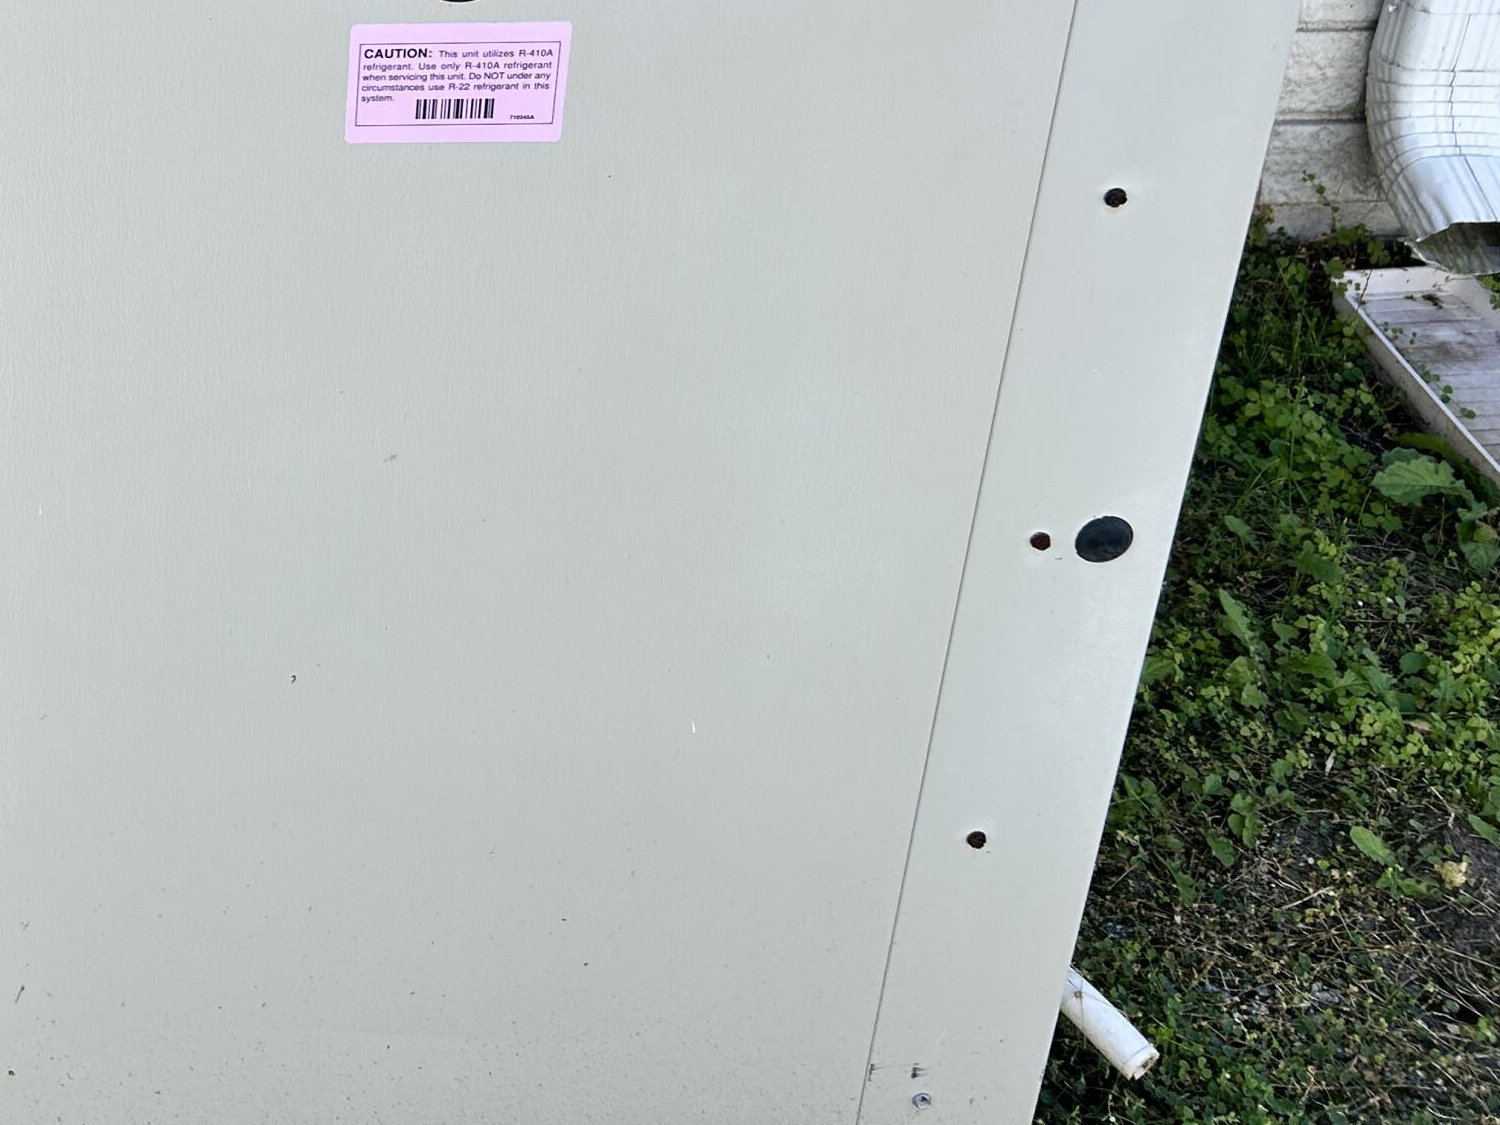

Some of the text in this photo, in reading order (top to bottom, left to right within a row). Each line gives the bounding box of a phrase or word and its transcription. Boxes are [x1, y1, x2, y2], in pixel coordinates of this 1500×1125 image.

[364, 48, 554, 59] CAUTION: This unit utilizes R-410A
[362, 63, 414, 72] refrigerant.
[441, 63, 460, 71] only
[465, 61, 500, 69] R-410A
[503, 61, 552, 70] refrigerant
[388, 74, 427, 82] servicing
[447, 72, 466, 80] unit.
[468, 72, 482, 80] Do
[483, 71, 505, 79] NOT
[361, 84, 424, 92] circumstances
[448, 82, 470, 90] R-22
[473, 82, 519, 92] refrigerant
[523, 82, 531, 90] in
[534, 82, 550, 90] this
[361, 94, 395, 103] system.
